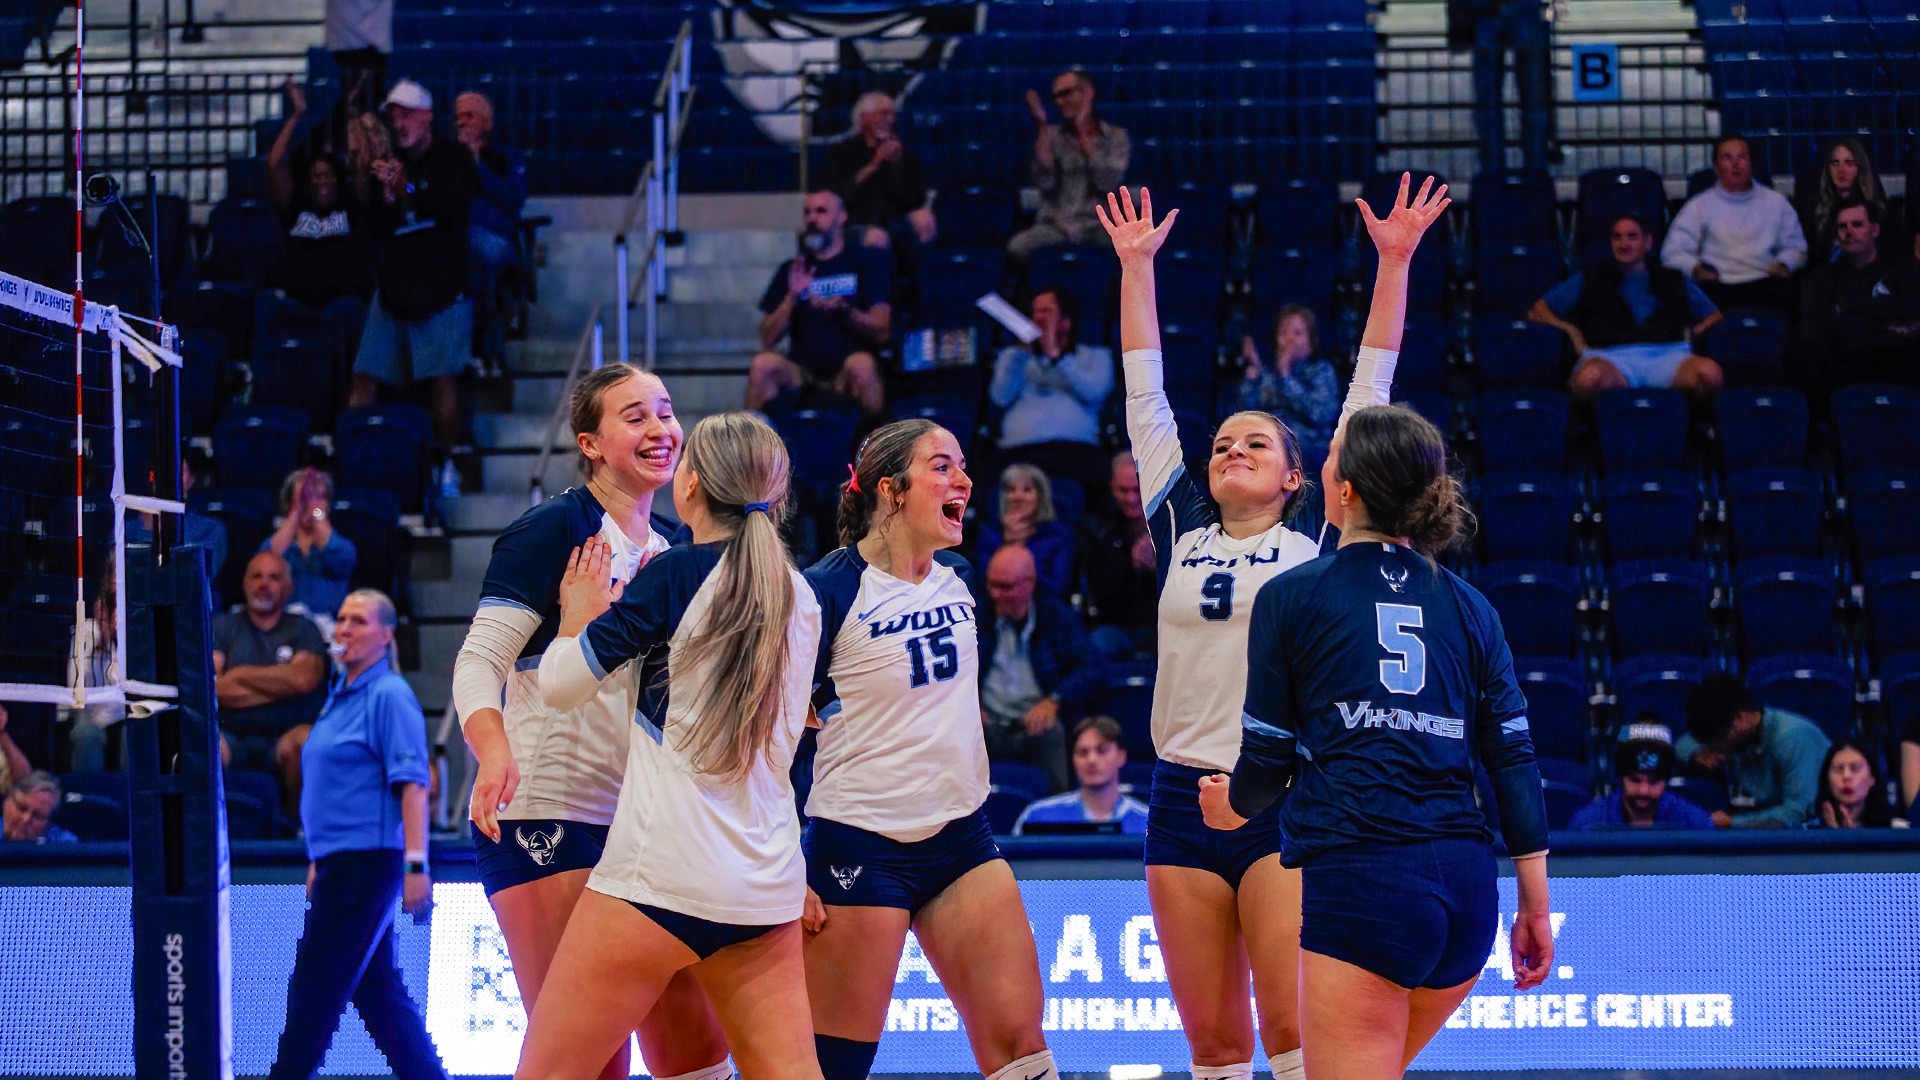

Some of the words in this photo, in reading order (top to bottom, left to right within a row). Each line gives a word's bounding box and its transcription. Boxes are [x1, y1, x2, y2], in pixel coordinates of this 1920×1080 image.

[1581, 52, 1611, 90] B
[1199, 571, 1237, 622] 9
[905, 626, 959, 689] 15
[1375, 602, 1426, 695] 5
[1334, 701, 1464, 739] VIKINGS
[1050, 914, 1103, 983] A
[884, 998, 959, 1031] NTS
[1445, 994, 1587, 1029] ERENCE
[1597, 993, 1733, 1028] CENTER
[164, 1005, 188, 1080] import
